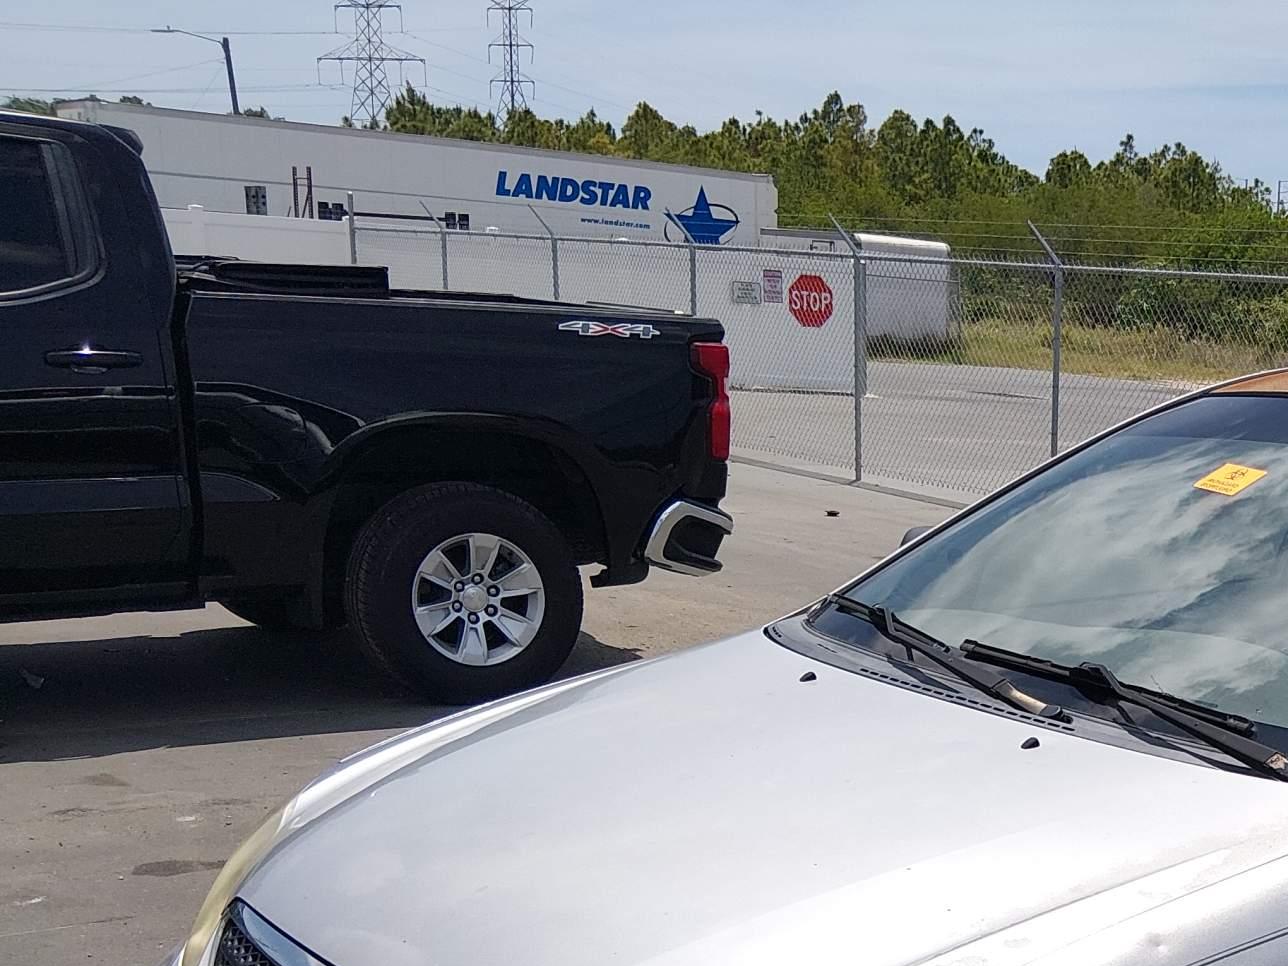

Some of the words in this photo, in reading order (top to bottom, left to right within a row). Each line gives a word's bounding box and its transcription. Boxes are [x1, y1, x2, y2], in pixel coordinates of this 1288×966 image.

[495, 170, 652, 211] LANDSTAR
[580, 215, 651, 230] www.landstar.com
[791, 289, 831, 312] STOP
